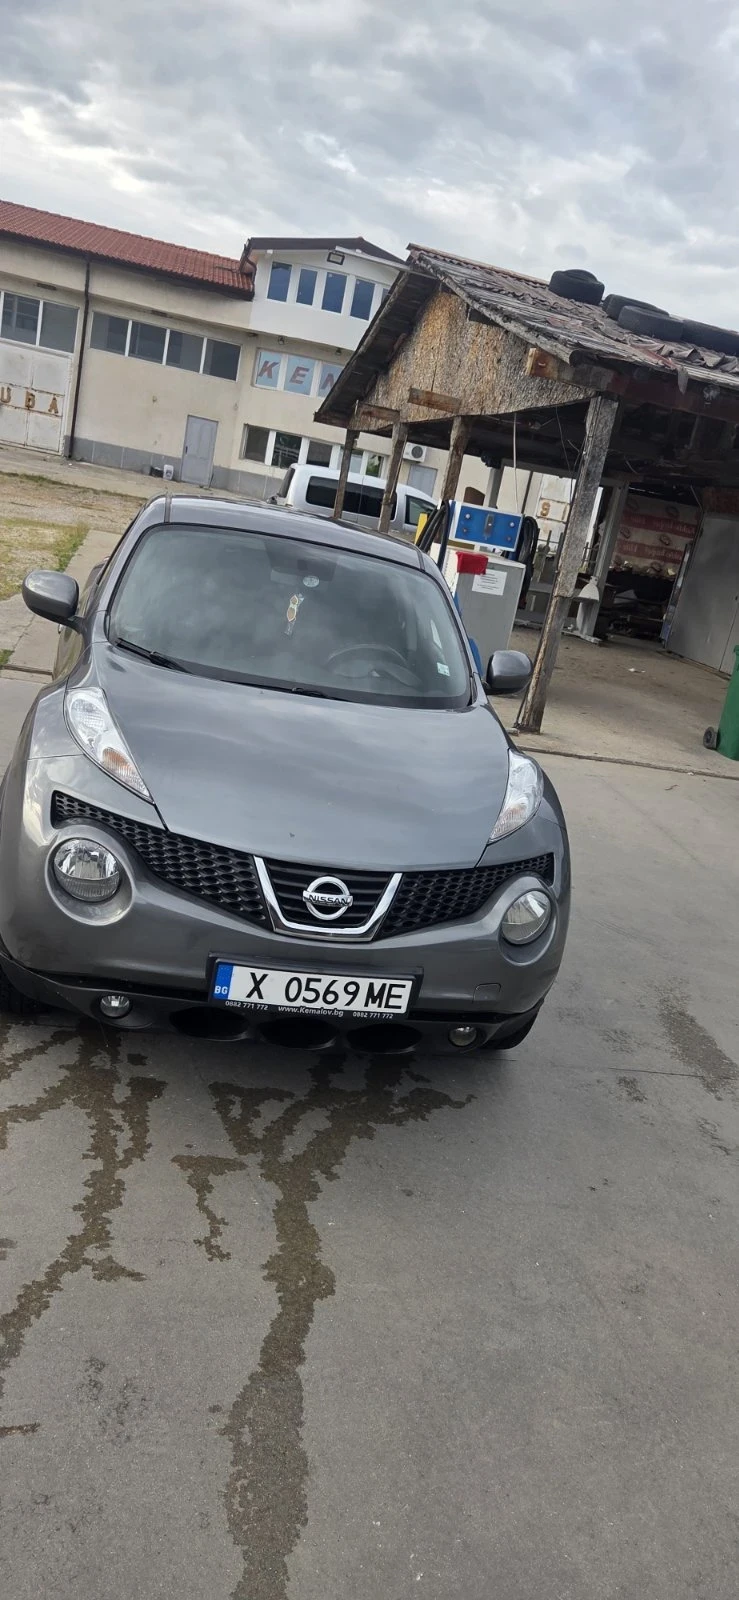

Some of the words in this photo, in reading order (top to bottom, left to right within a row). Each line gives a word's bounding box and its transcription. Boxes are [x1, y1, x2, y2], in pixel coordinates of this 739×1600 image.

[308, 894, 348, 906] NISSAN
[214, 986, 228, 995] BG
[245, 972, 269, 1000] X
[284, 976, 360, 1007] 0569
[364, 982, 406, 1010] ME
[278, 1005, 344, 1017] www.Kemalov.bg
